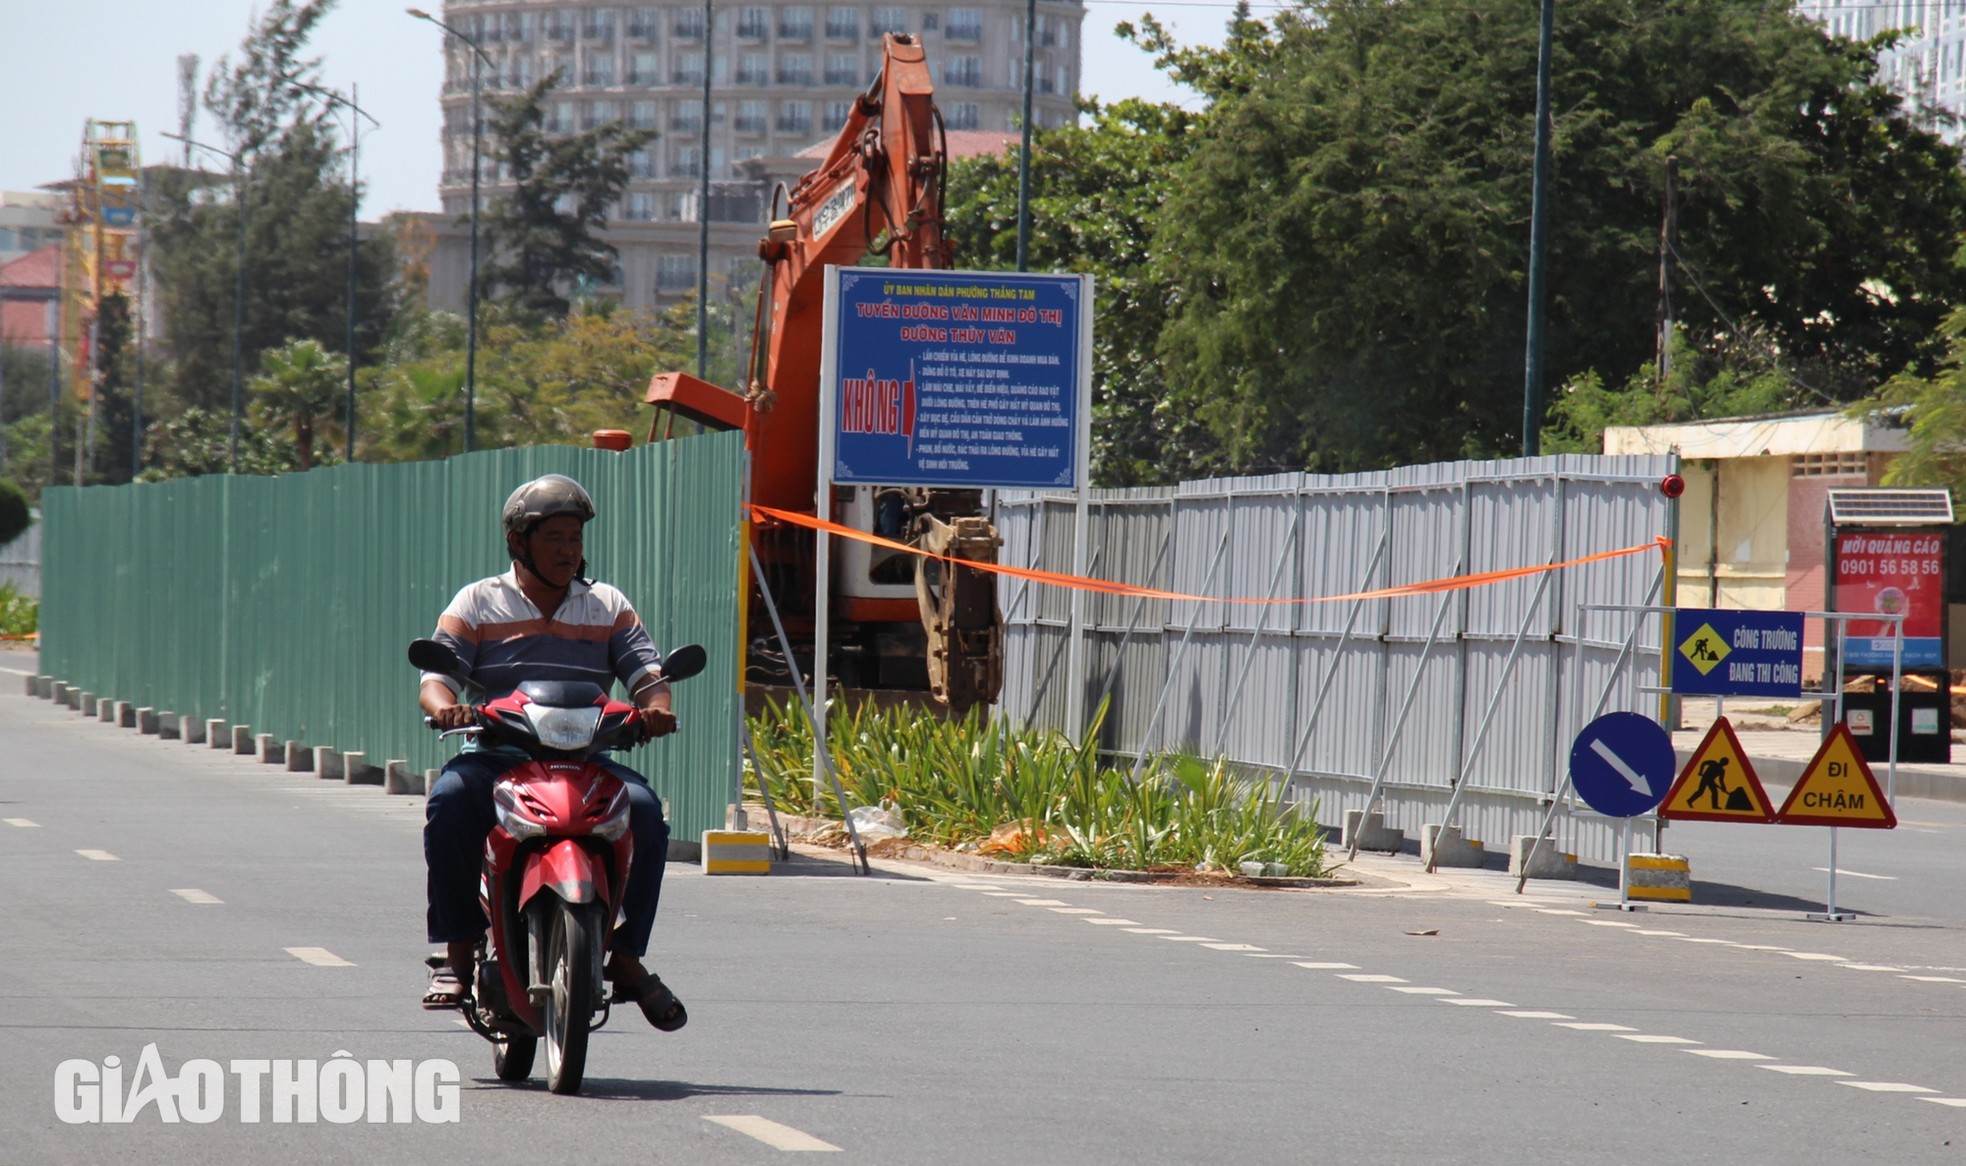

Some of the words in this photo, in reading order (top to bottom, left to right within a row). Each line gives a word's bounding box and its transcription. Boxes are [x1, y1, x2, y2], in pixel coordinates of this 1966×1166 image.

[884, 281, 894, 294] ỦY
[896, 285, 912, 295] BAN
[914, 284, 936, 296] NHÂN
[938, 286, 953, 297] DÂN
[956, 286, 988, 298] PHƯỜNG
[990, 285, 1016, 299] THẮNG
[1018, 289, 1035, 300] TAM
[856, 298, 899, 318] TUYẾN
[902, 302, 948, 320] ĐƯỜNG
[952, 304, 978, 321] VĂN
[981, 308, 1014, 322] MINH
[1018, 306, 1037, 322] ĐÔ
[1040, 309, 1062, 327] THỊ
[901, 324, 947, 342] ĐƯỜNG
[988, 328, 1016, 344] VÂN
[842, 368, 899, 434] KHÔNG
[1841, 535, 1867, 554] MỜI
[1867, 534, 1911, 554] QUẢNG
[1913, 535, 1940, 554] CÁO
[1841, 560, 1874, 575] 0901
[1880, 560, 1897, 575] 56
[1901, 560, 1918, 575] 58
[1922, 560, 1940, 575] 56
[1734, 625, 1760, 650] CÔNG
[1761, 625, 1798, 651] TRƯỜNG
[1729, 662, 1754, 682] ĐANG
[1756, 663, 1772, 683] THI
[1773, 660, 1798, 684] CÔNG
[1828, 761, 1848, 778] ĐI
[1803, 788, 1864, 813] CHẬM
